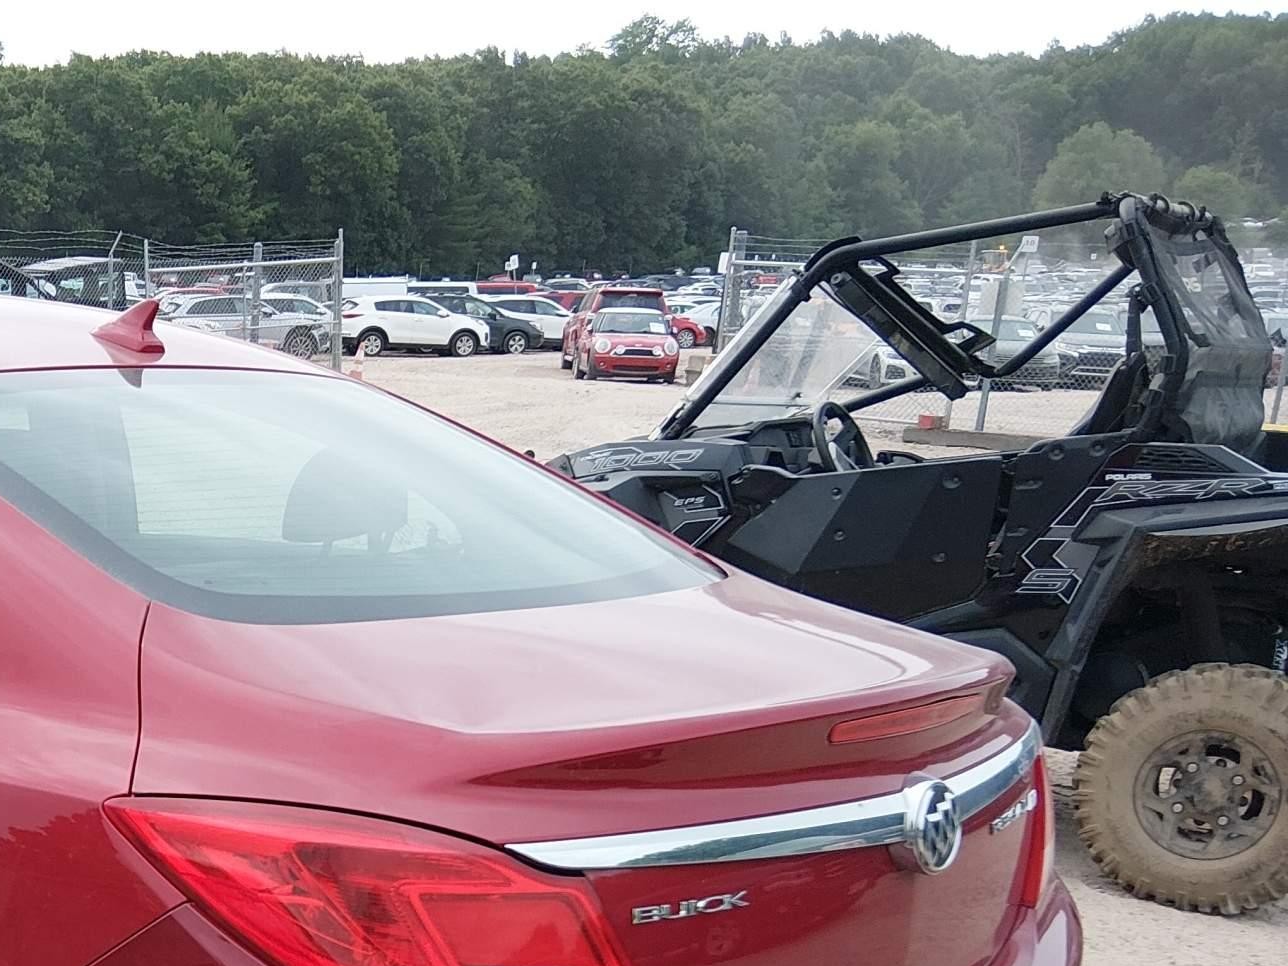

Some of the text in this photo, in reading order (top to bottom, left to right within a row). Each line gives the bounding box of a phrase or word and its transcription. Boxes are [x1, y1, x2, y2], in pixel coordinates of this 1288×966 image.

[1105, 473, 1152, 481] POLARIS
[1095, 478, 1266, 500] RZR
[673, 496, 706, 506] EPS
[632, 889, 751, 924] BUICK
